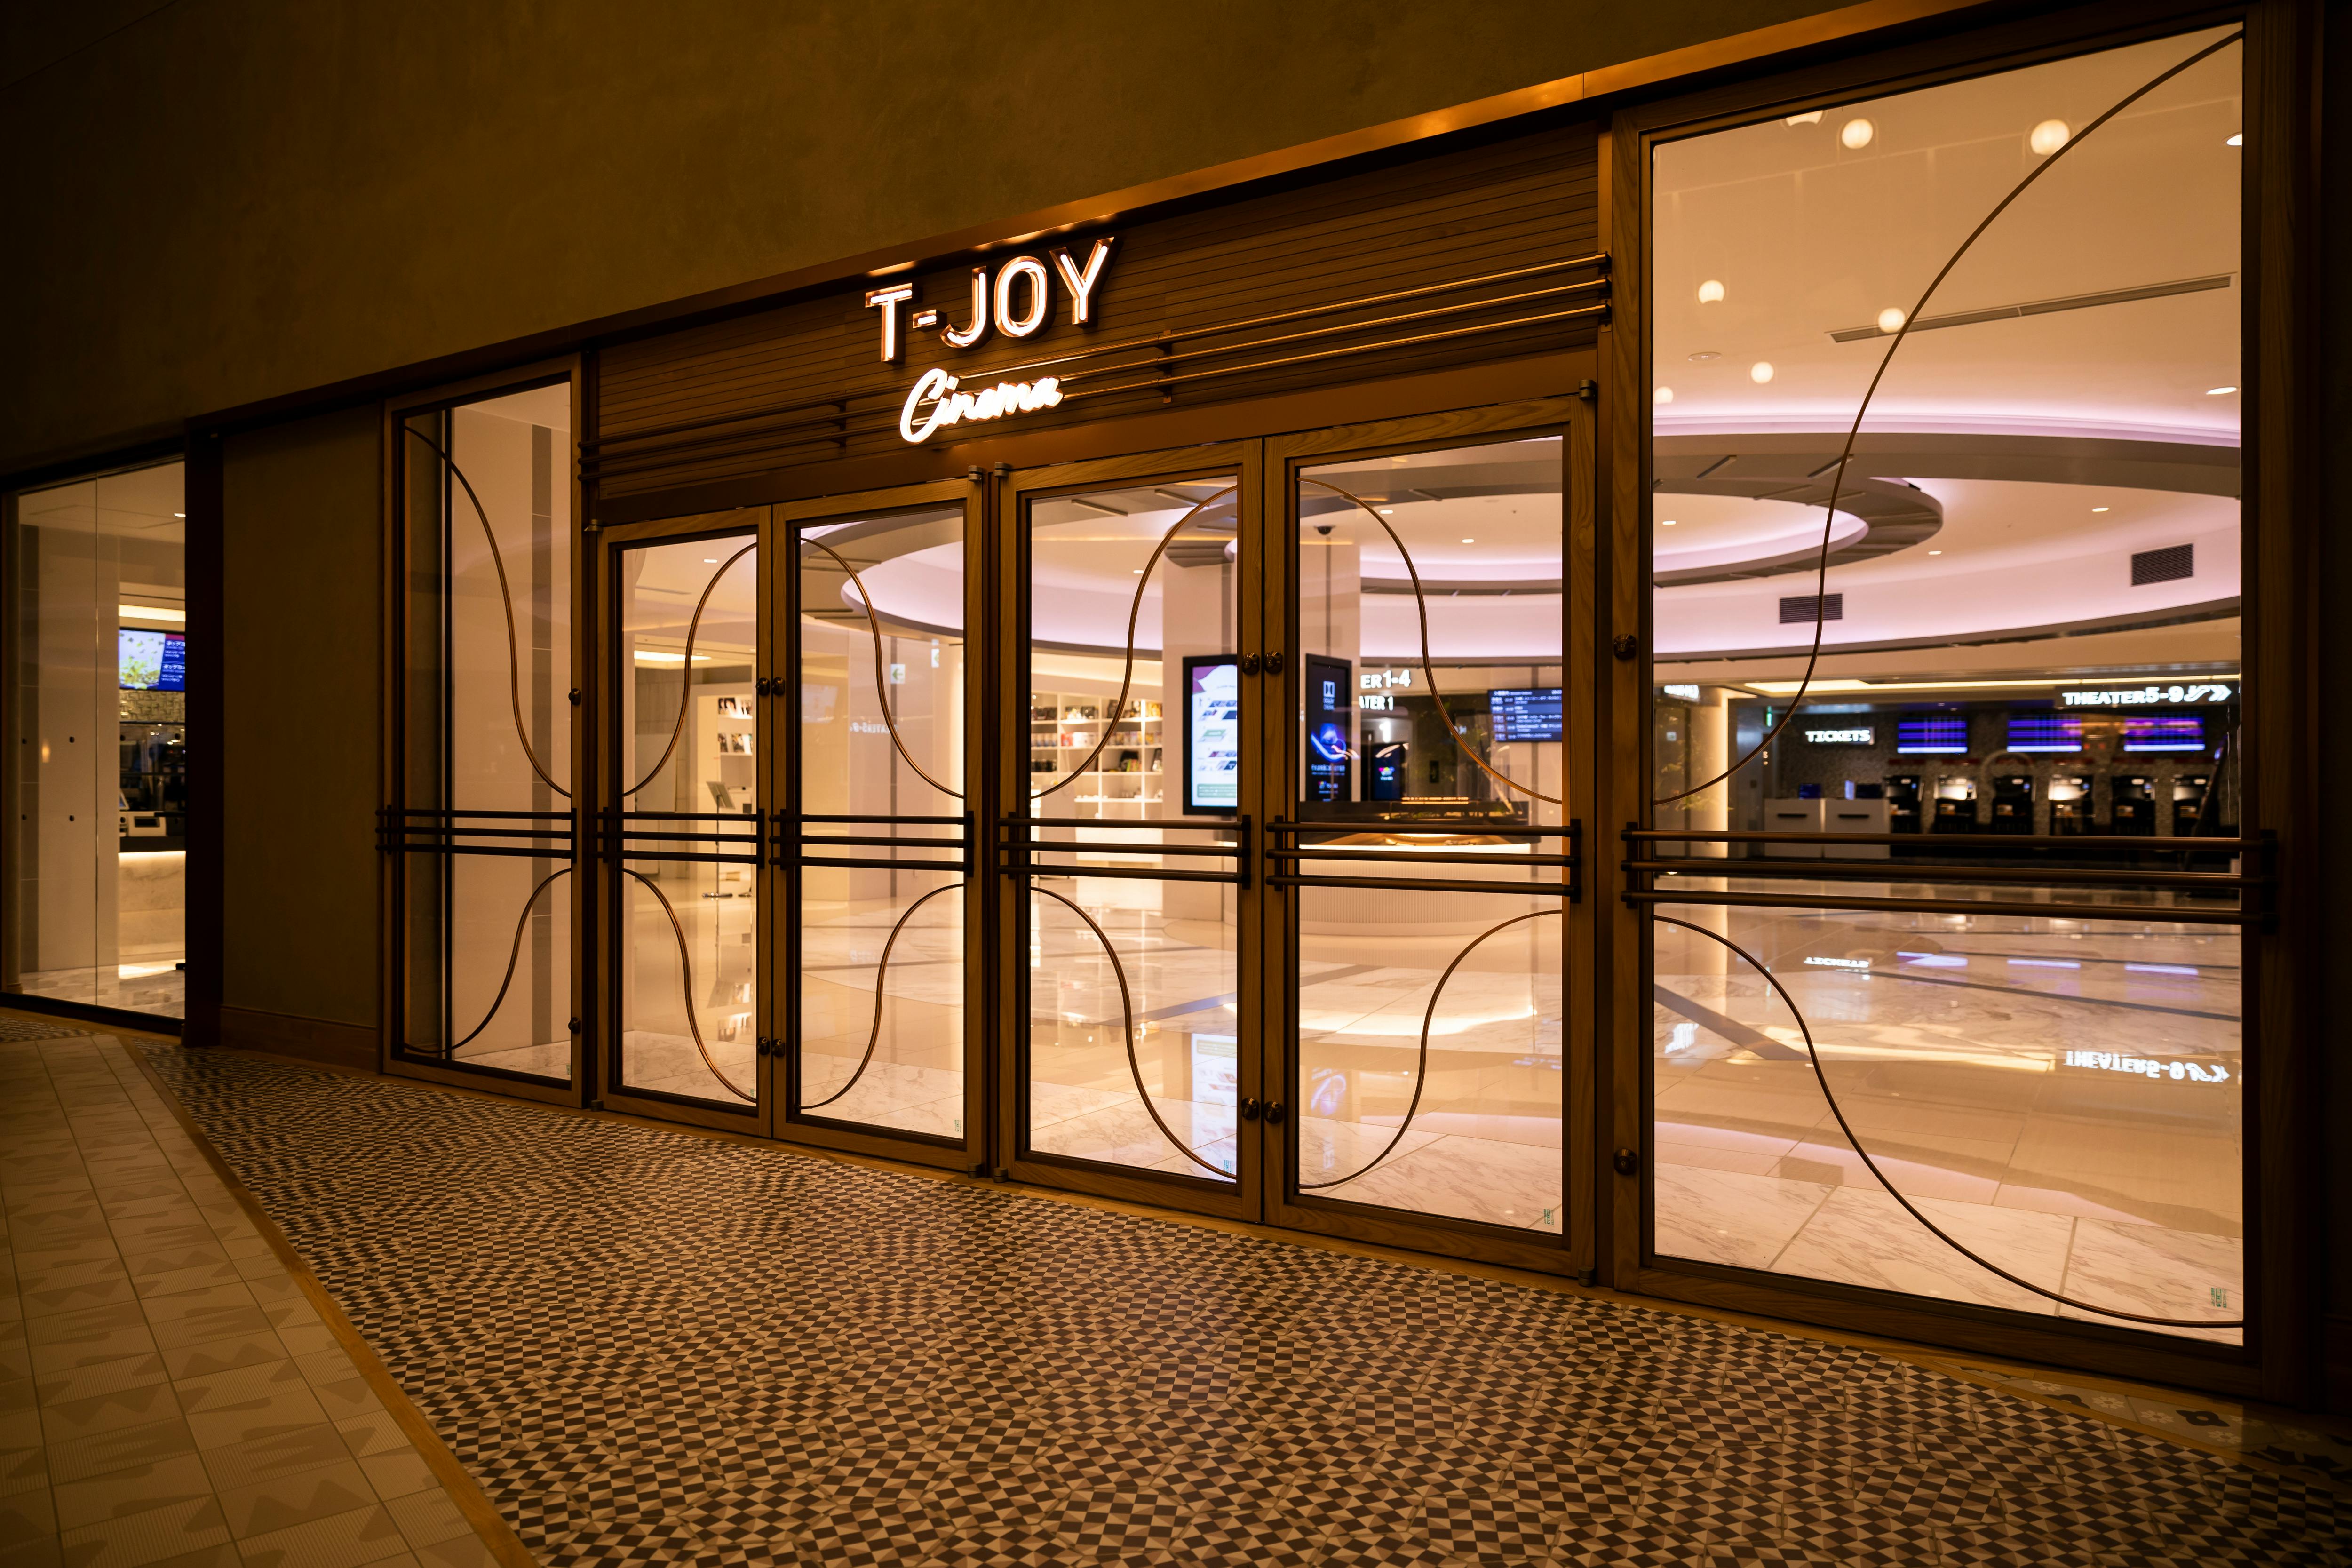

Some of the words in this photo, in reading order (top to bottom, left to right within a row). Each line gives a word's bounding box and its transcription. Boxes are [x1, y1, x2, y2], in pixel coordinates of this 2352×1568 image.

[866, 237, 1114, 362] T-JOY
[900, 368, 1064, 444] Cinema
[1387, 696, 1393, 711] 1
[1805, 730, 1871, 743] TICKETS
